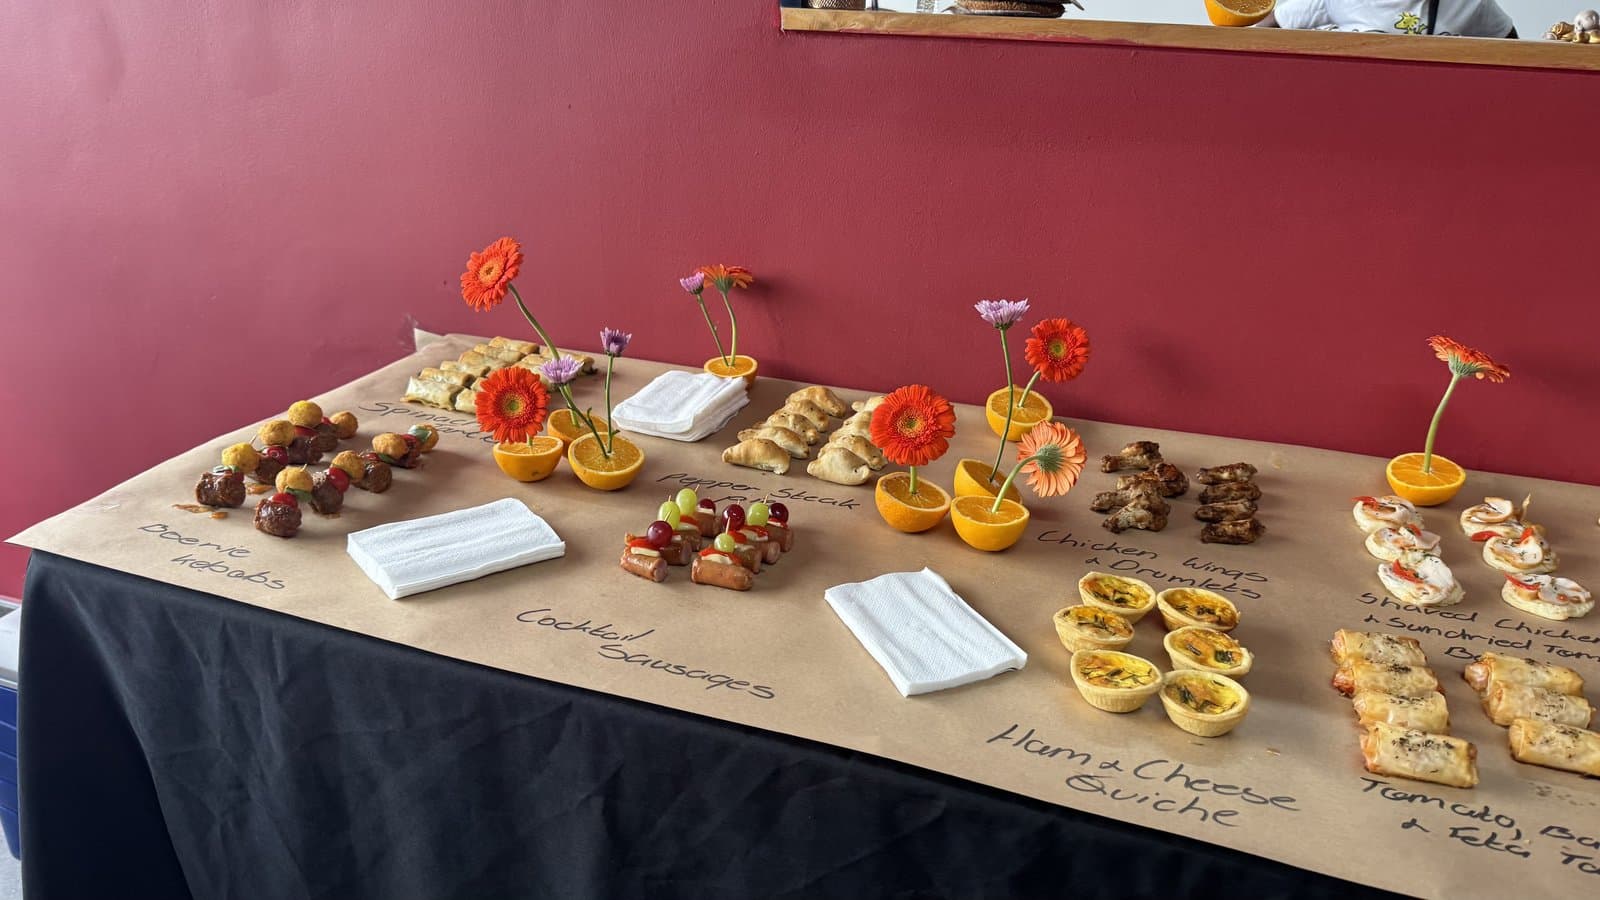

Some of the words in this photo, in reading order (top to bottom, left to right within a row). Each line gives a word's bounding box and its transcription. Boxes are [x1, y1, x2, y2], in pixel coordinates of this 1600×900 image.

[656, 472, 760, 491] Pepper
[769, 487, 861, 510] Steak
[1037, 529, 1158, 560] Chicken
[1182, 556, 1268, 583] Wings
[1109, 559, 1262, 600] Drumlets
[516, 608, 655, 642] Cocktail
[1355, 592, 1479, 623] Shaved
[1386, 616, 1533, 651] Sundried
[597, 643, 775, 700] Sausages
[986, 724, 1091, 765] Ham
[1133, 759, 1302, 812] Cheese
[1065, 773, 1242, 828] Quiche
[1448, 826, 1531, 859] Feta
